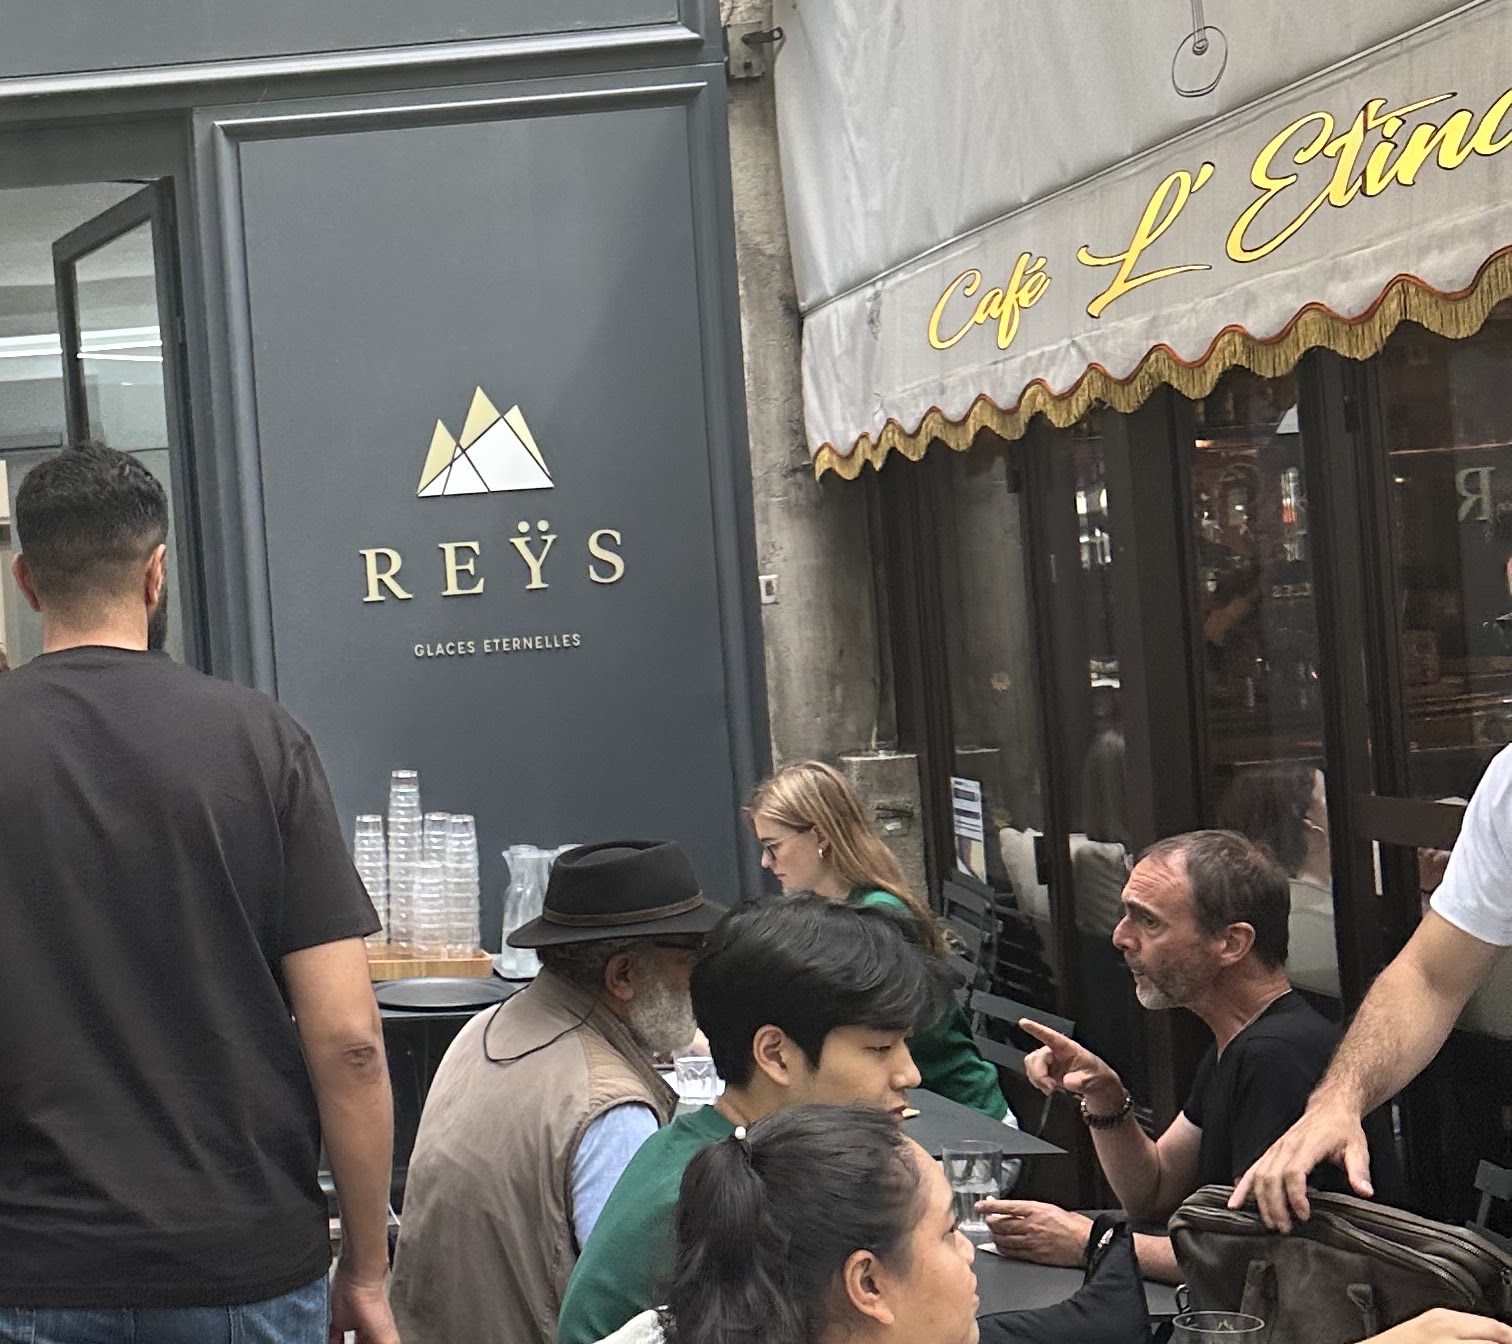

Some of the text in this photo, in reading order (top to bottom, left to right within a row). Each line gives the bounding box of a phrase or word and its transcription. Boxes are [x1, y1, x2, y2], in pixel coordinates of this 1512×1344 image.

[927, 250, 1053, 350] Café
[358, 519, 626, 603] REŸS
[413, 633, 582, 657] GLACES ETERNELLES
